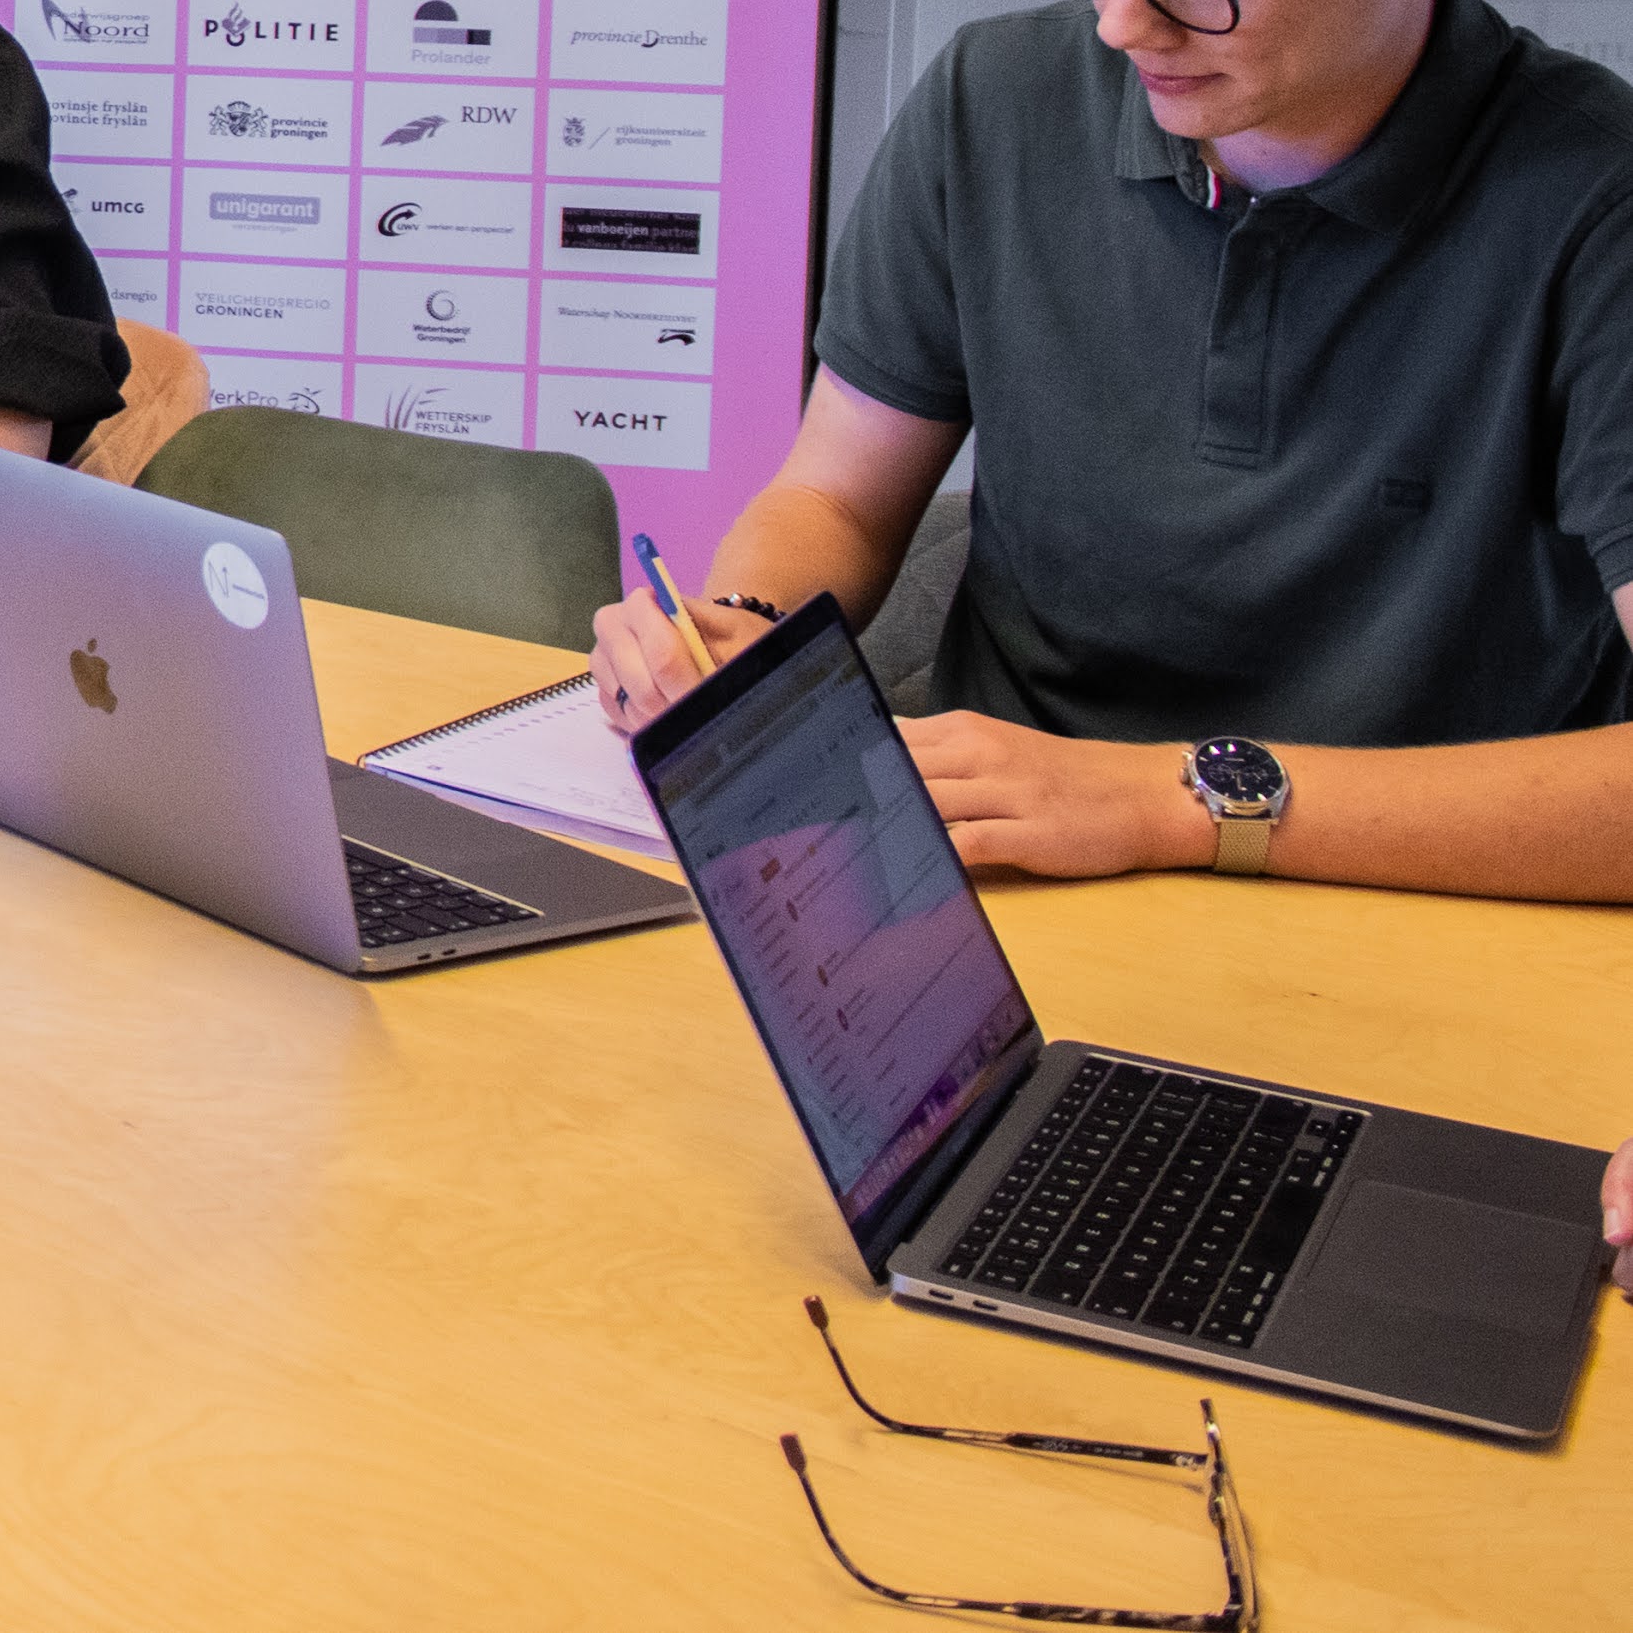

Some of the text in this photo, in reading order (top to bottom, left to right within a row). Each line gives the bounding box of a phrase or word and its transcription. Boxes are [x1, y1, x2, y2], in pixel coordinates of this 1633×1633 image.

[64, 22, 150, 38] Noord
[570, 30, 709, 48] provincie Drenthe
[411, 49, 492, 65] Prolander
[49, 99, 99, 115] ovinsje
[460, 106, 518, 124] RDW
[271, 117, 329, 129] provincie
[270, 128, 328, 140] groningen
[215, 198, 316, 222] unigarant
[195, 293, 331, 311] VEILIGHEIDSREGIO
[195, 304, 284, 320] GRONINGEN
[415, 409, 492, 425] WETTERSKIP
[574, 409, 668, 431] YACHT
